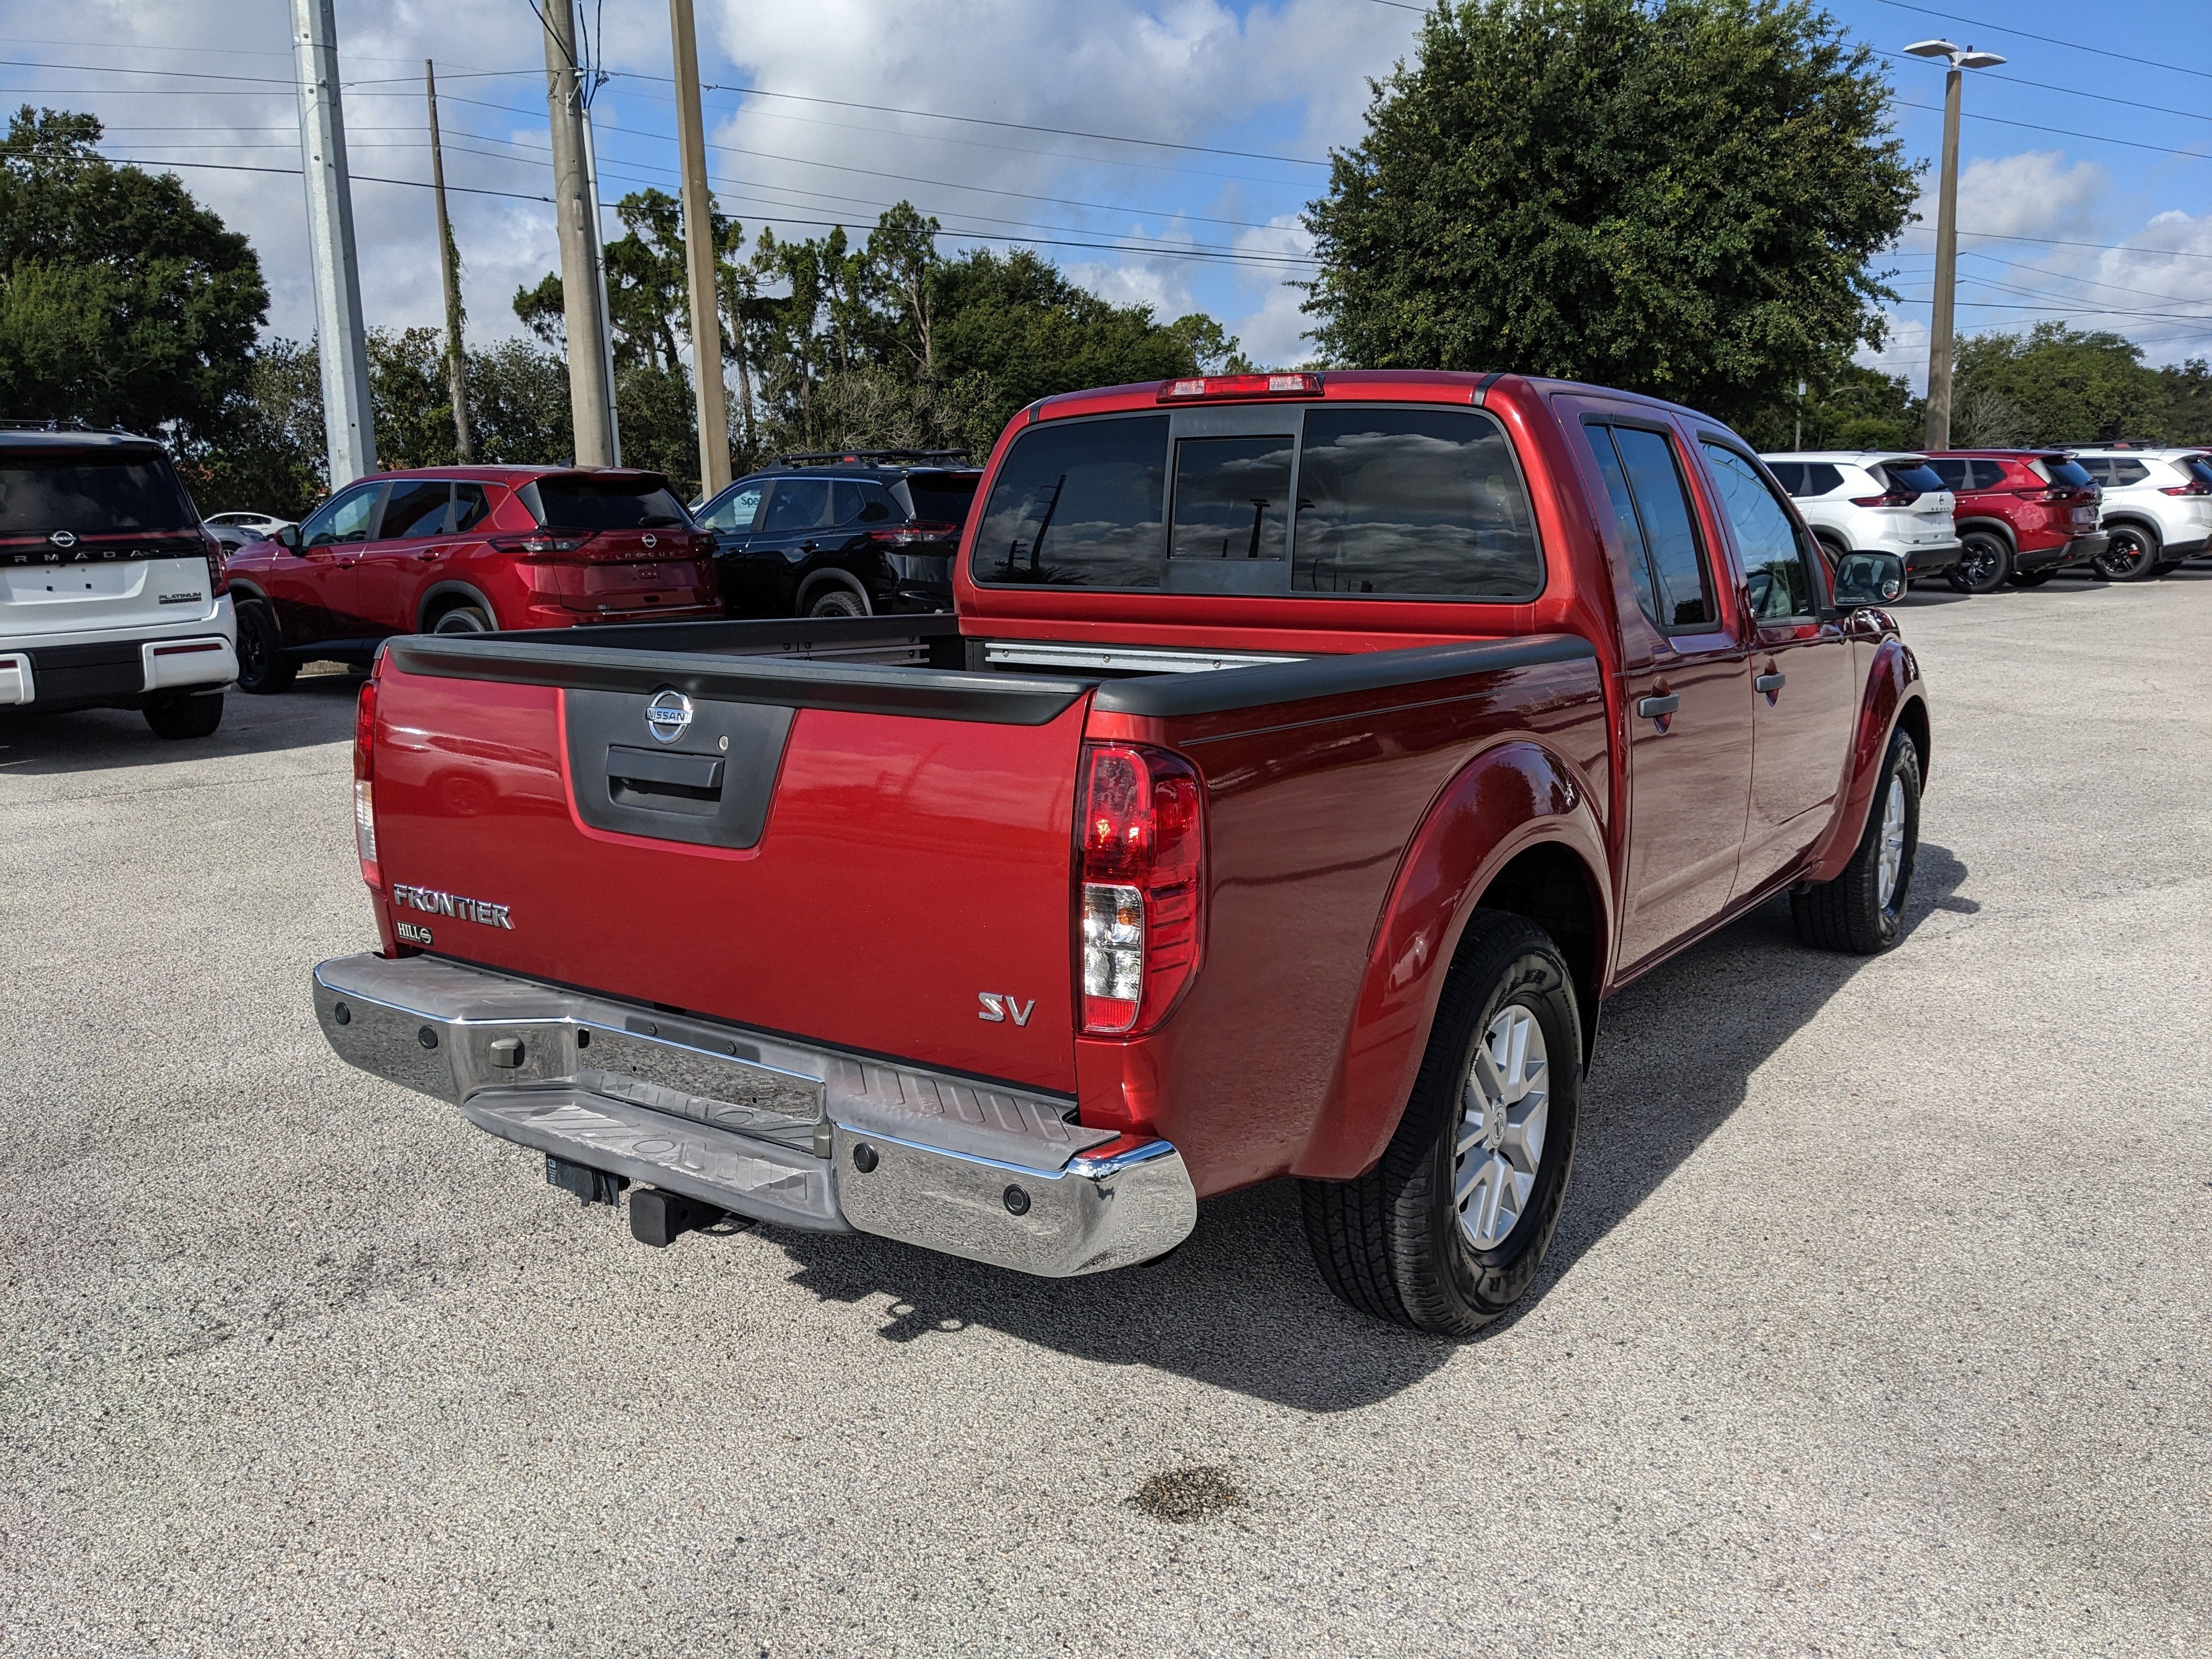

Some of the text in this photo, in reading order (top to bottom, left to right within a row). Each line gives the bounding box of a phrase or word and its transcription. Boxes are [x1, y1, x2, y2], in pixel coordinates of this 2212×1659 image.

[648, 710, 685, 721] NISSAN
[394, 883, 516, 930] FRONTIER
[978, 991, 1036, 1027] SV
